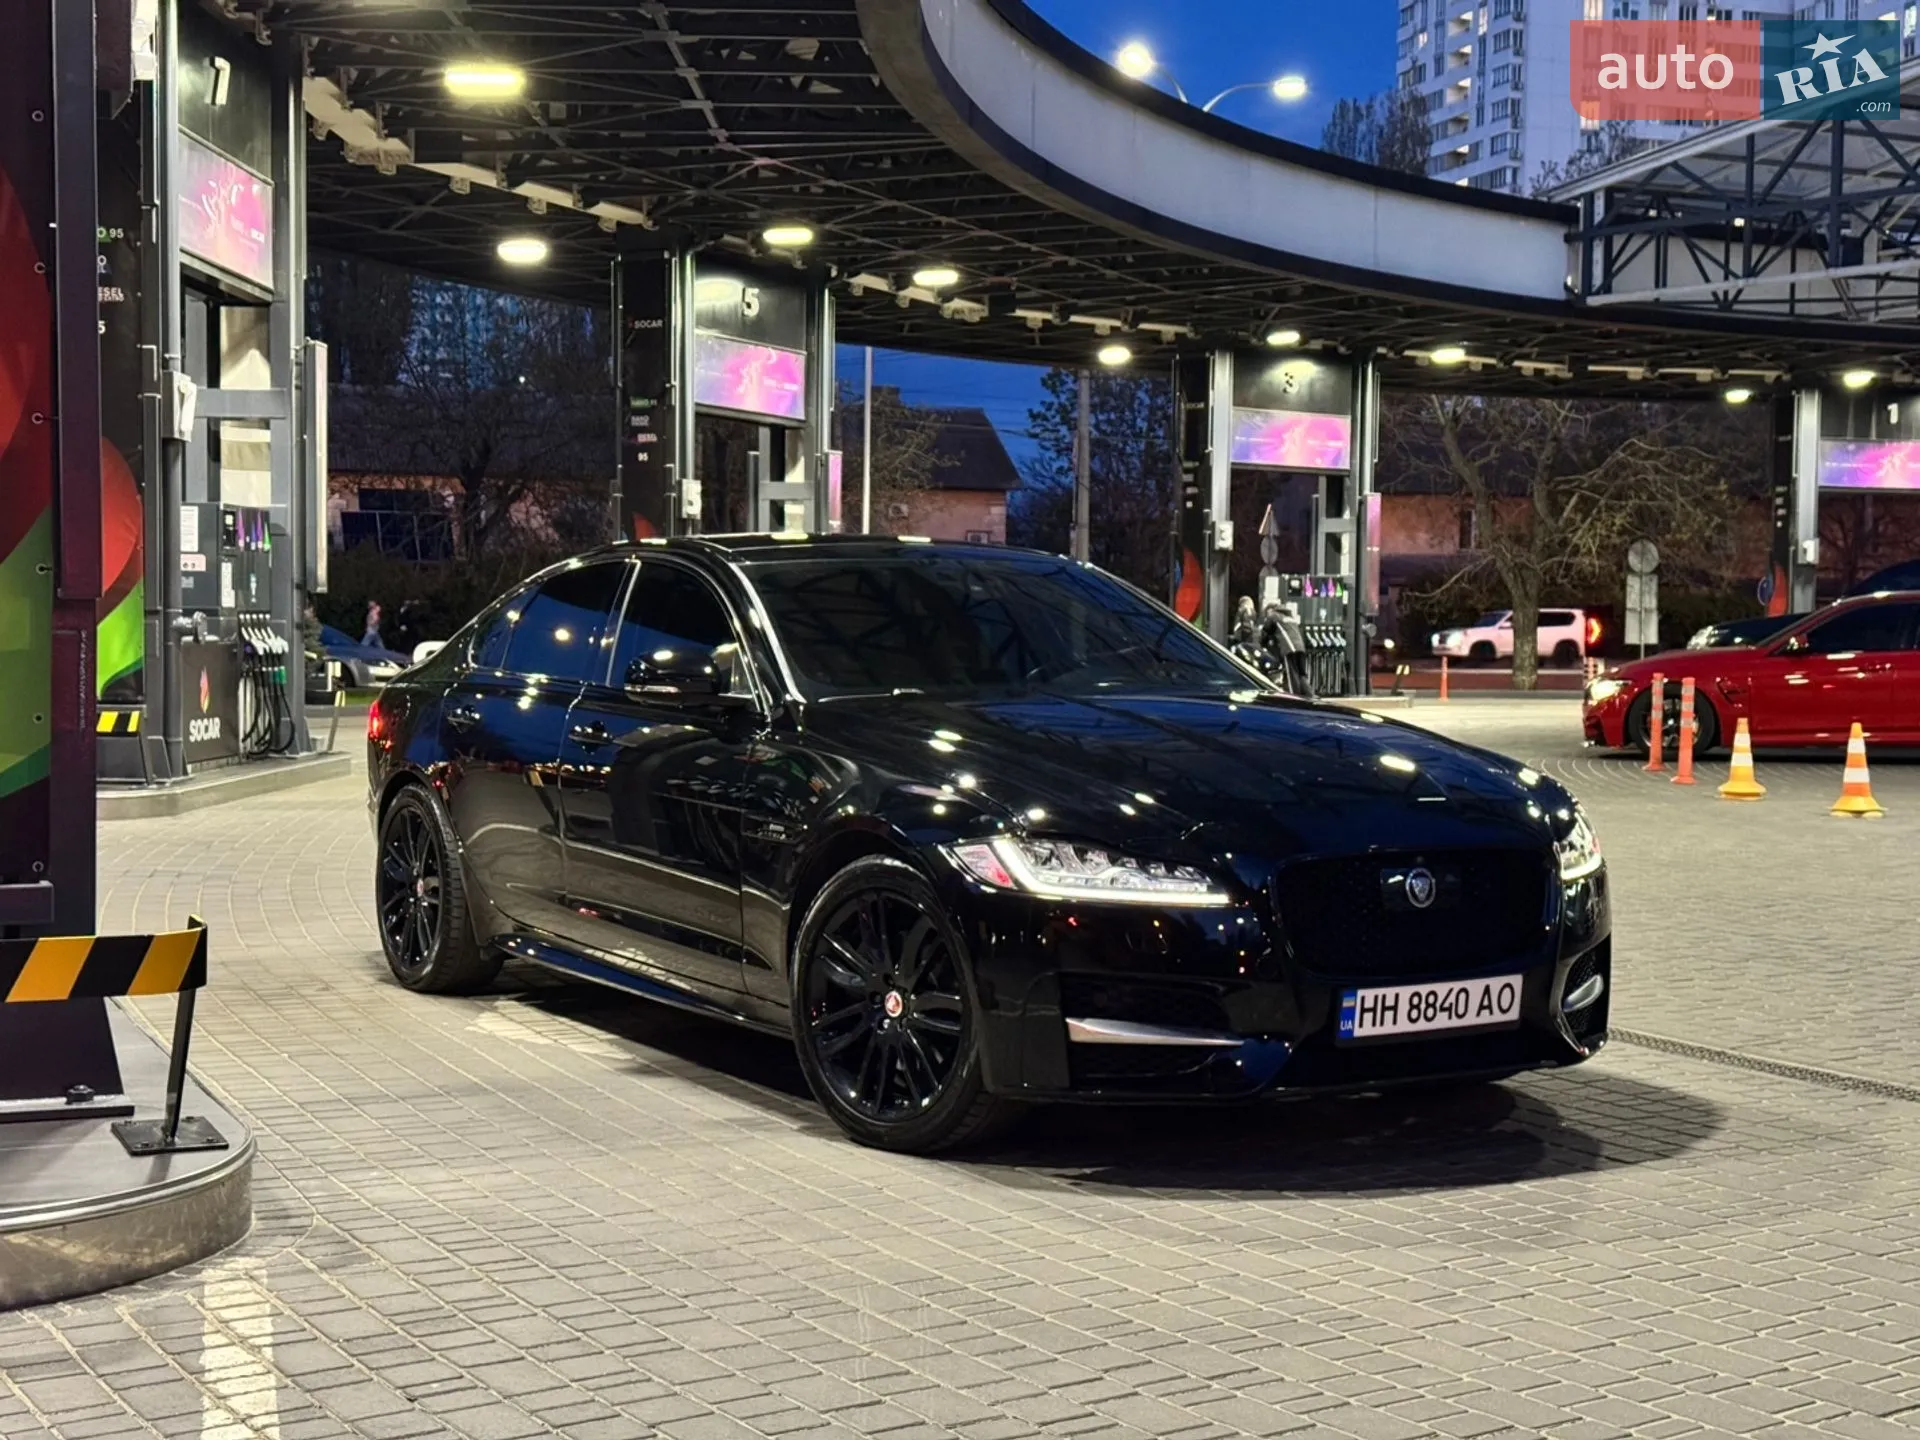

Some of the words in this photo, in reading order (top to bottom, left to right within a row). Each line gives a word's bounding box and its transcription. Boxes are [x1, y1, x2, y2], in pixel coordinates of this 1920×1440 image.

[209, 56, 231, 105] 7
[109, 228, 124, 238] 95
[742, 287, 760, 317] 5
[97, 321, 106, 334] 5
[634, 320, 663, 328] SOCAR
[1887, 403, 1898, 424] 1
[638, 453, 648, 461] 95
[1803, 540, 1815, 562] 1
[189, 717, 221, 742] SOCAR
[1358, 991, 1399, 1028] HH
[1407, 986, 1469, 1025] 8840
[1476, 982, 1516, 1017] AO
[1340, 1019, 1353, 1031] UA
